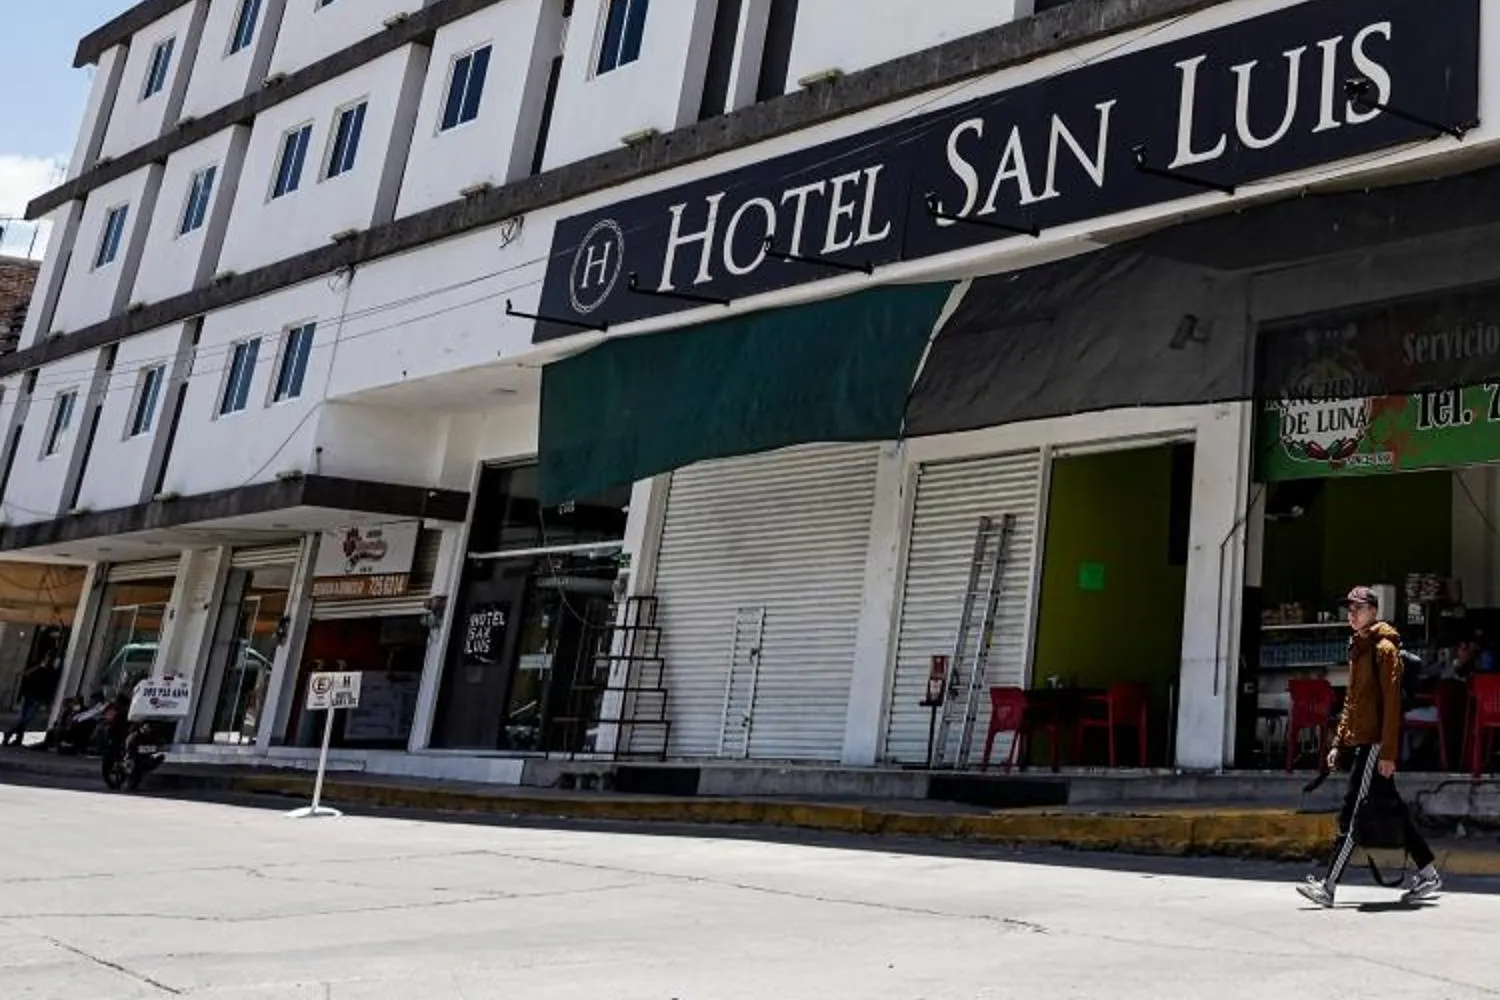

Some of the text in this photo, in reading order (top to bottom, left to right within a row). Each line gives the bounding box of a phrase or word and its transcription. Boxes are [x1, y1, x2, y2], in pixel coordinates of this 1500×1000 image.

[657, 21, 1392, 292] HOTEL SAN LUIS
[581, 242, 610, 289] H
[1402, 321, 1500, 366] Servicio
[1282, 405, 1368, 437] DE LUNA
[1411, 385, 1473, 430] Tel.
